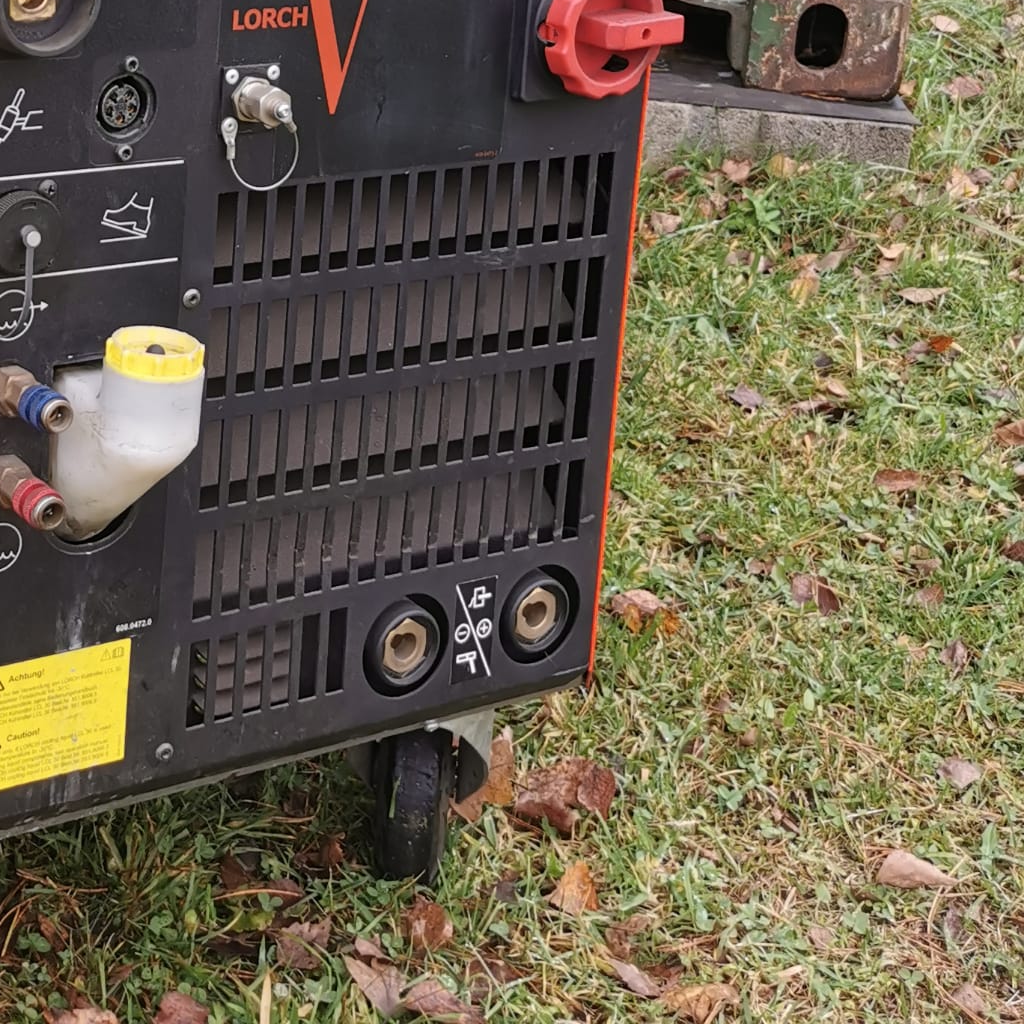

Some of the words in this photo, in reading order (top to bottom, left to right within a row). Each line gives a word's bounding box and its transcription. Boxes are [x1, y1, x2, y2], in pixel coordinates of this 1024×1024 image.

[231, 5, 309, 32] LORCH
[8, 668, 46, 684] Achtung!
[6, 727, 41, 743] Caution!
